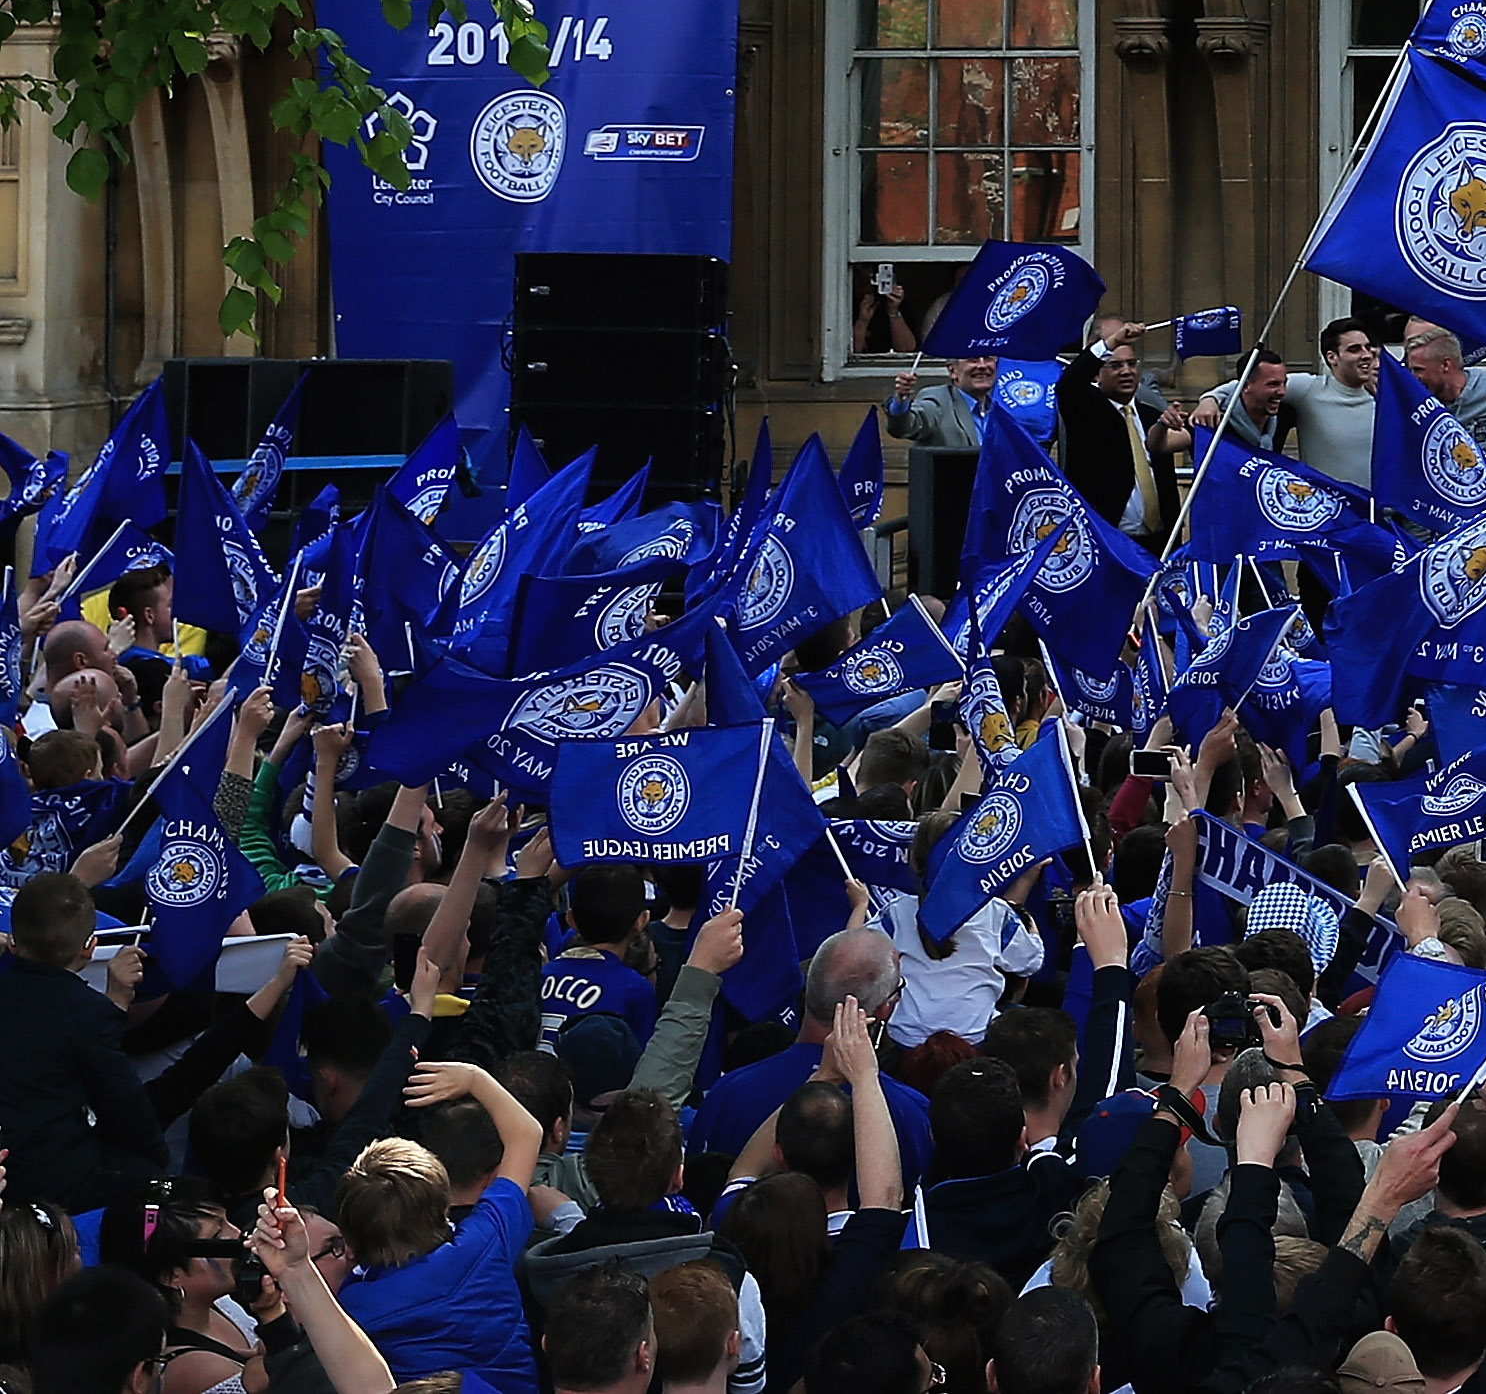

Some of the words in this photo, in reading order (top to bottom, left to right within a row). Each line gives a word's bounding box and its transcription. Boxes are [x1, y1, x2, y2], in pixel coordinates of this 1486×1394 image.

[427, 17, 613, 67] 201/14
[482, 100, 549, 144] LEICESTER
[627, 131, 650, 146] sky
[655, 132, 686, 146] BET
[481, 152, 543, 193] FOOTBALL
[373, 193, 394, 206] City
[395, 192, 434, 206] Council
[1407, 184, 1474, 284] FOOTBALL
[1428, 448, 1468, 499] FOOTBALL
[1264, 490, 1320, 525] FOOTBALL
[1429, 505, 1455, 523] MAY
[1048, 564, 1083, 585] CLUB
[1077, 699, 1117, 721] 2013/14
[1425, 768, 1446, 792] WE
[1408, 823, 1463, 852] EMIER
